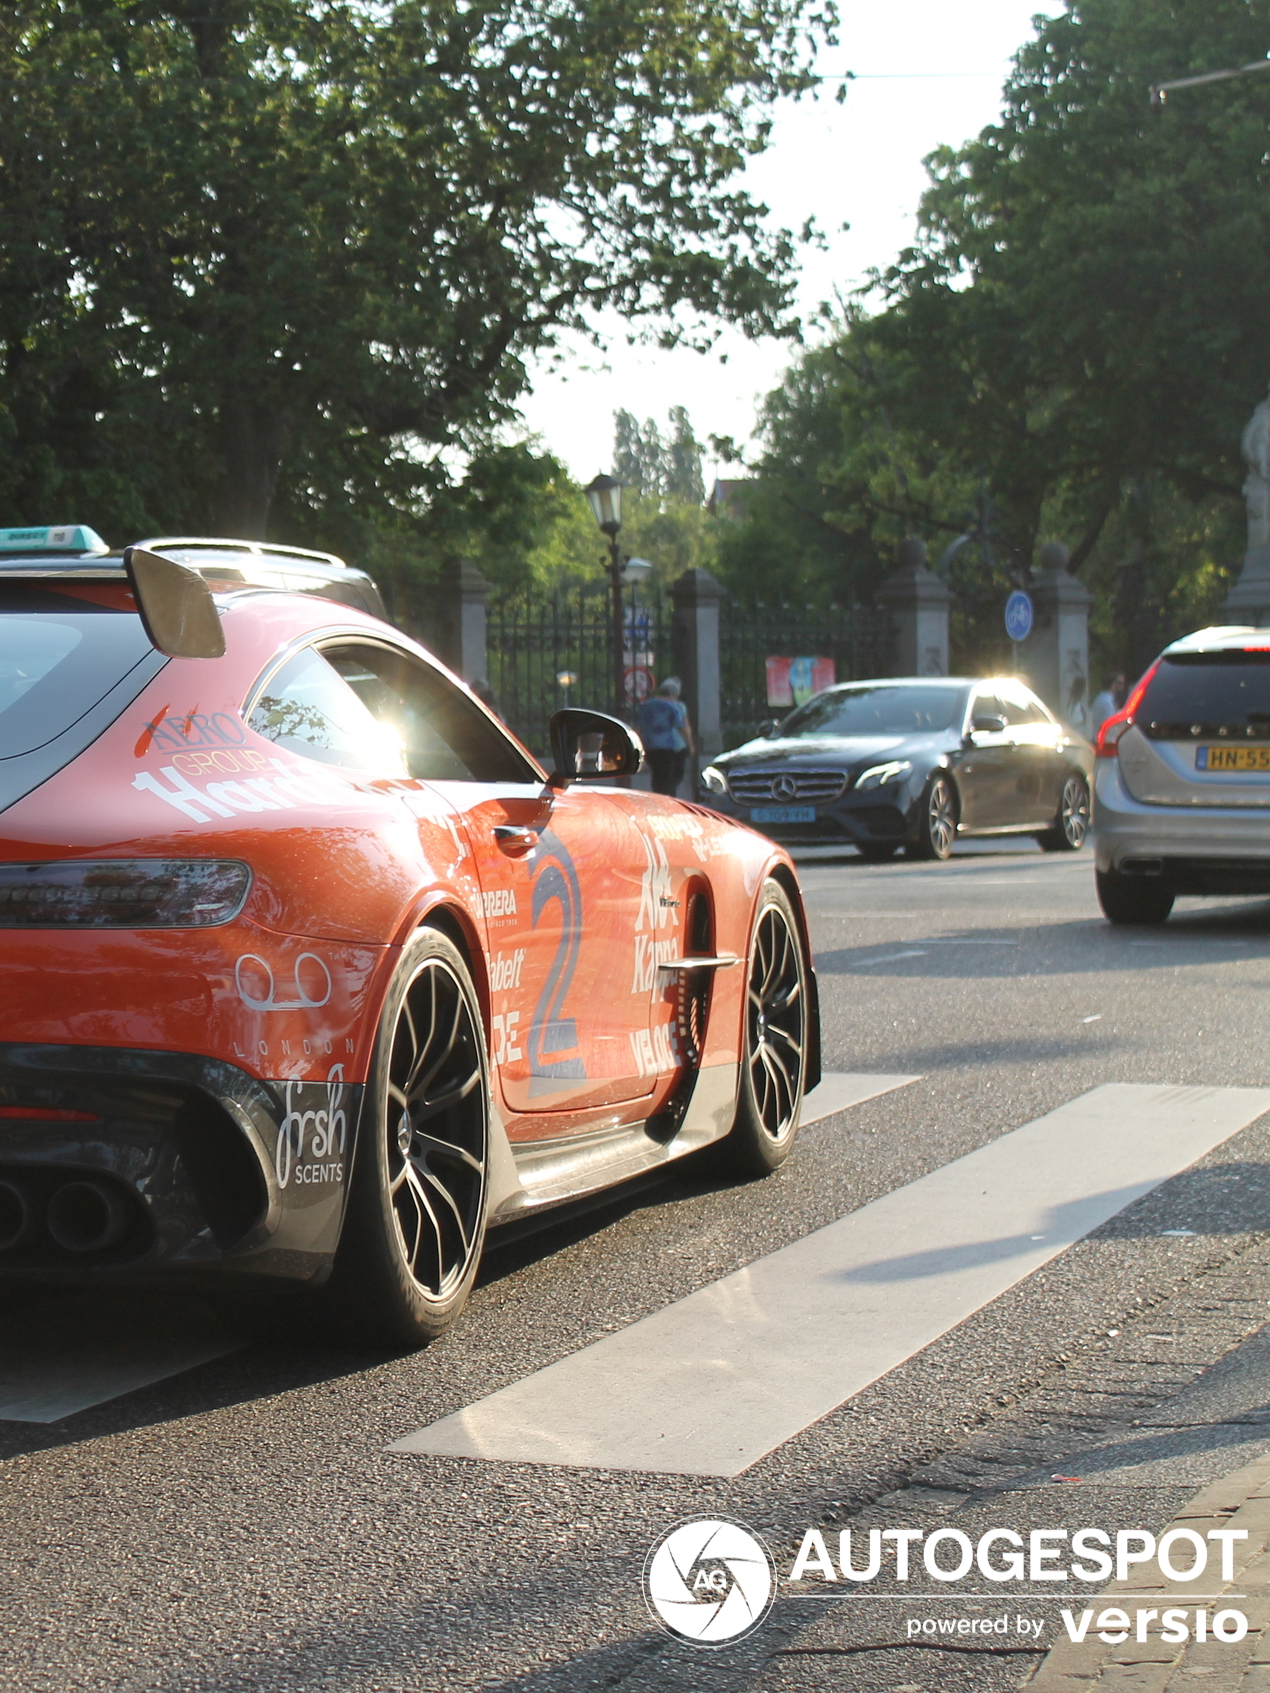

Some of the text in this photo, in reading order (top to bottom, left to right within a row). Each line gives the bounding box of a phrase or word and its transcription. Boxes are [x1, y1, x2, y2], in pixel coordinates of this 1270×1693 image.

[142, 711, 247, 751] AERO
[172, 751, 267, 777] GROUP
[527, 827, 587, 1100] 2
[631, 934, 679, 1004] Kappa
[233, 1038, 354, 1058] LONDON
[630, 1020, 682, 1079] VELOCE
[294, 1163, 344, 1185] SCENTS
